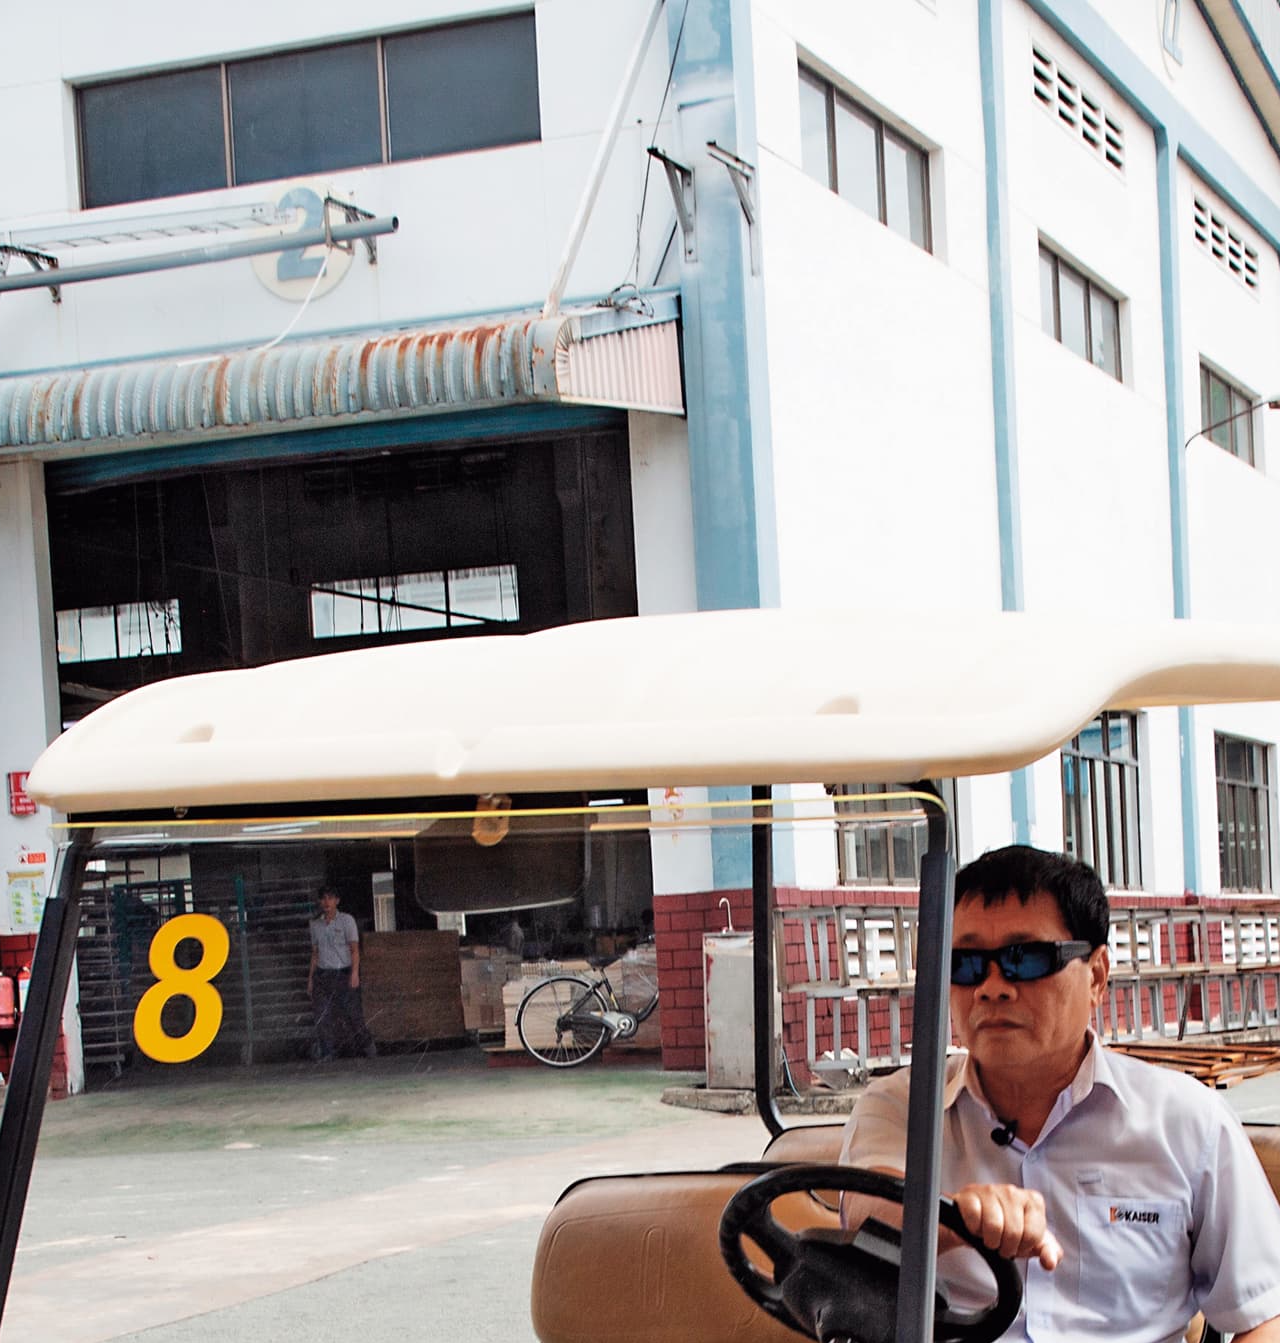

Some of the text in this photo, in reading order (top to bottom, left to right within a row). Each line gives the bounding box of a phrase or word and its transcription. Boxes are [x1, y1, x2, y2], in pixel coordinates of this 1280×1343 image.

[277, 187, 326, 281] 2
[133, 913, 230, 1063] 8
[1124, 1209, 1160, 1224] KAISER
